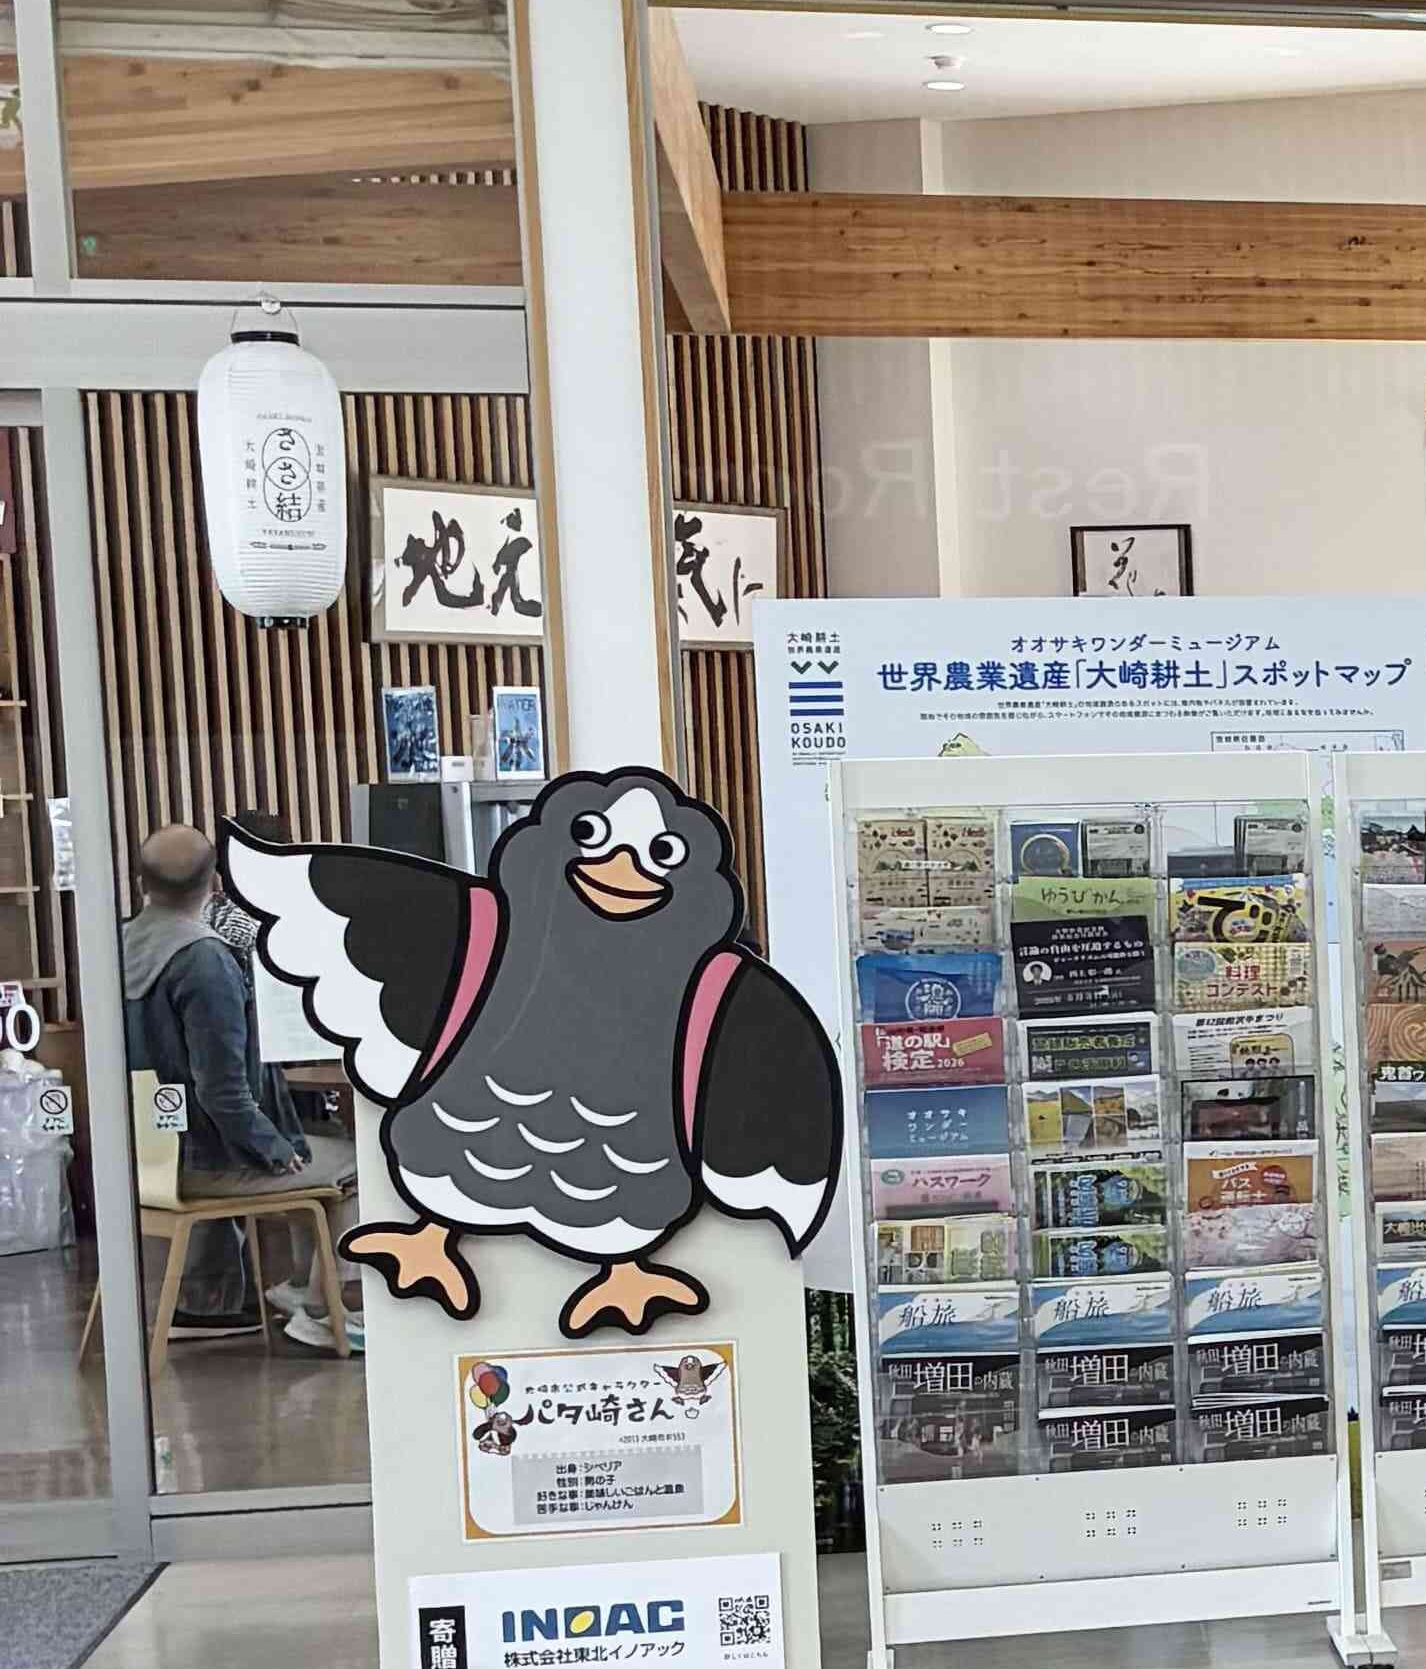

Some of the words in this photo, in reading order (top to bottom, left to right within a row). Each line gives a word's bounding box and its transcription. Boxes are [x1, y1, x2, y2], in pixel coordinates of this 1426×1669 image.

[787, 632, 841, 644] 大崎耕土
[1011, 633, 1281, 654] オオサキワンダーミュージアム
[877, 658, 1413, 692] 世界農業遺産「大崎耕土」スポットマップ
[791, 722, 844, 734] OSAKI
[791, 736, 846, 749] KOUDO
[1040, 885, 1122, 905] ゆうびかん
[1224, 965, 1262, 981] 料理
[1206, 983, 1280, 999] コンテスト
[881, 1049, 936, 1072] 検定
[512, 1393, 675, 1427] パタ崎さん
[502, 1599, 687, 1643] INOAC
[503, 1640, 686, 1669] 株式会社東北イノアック
